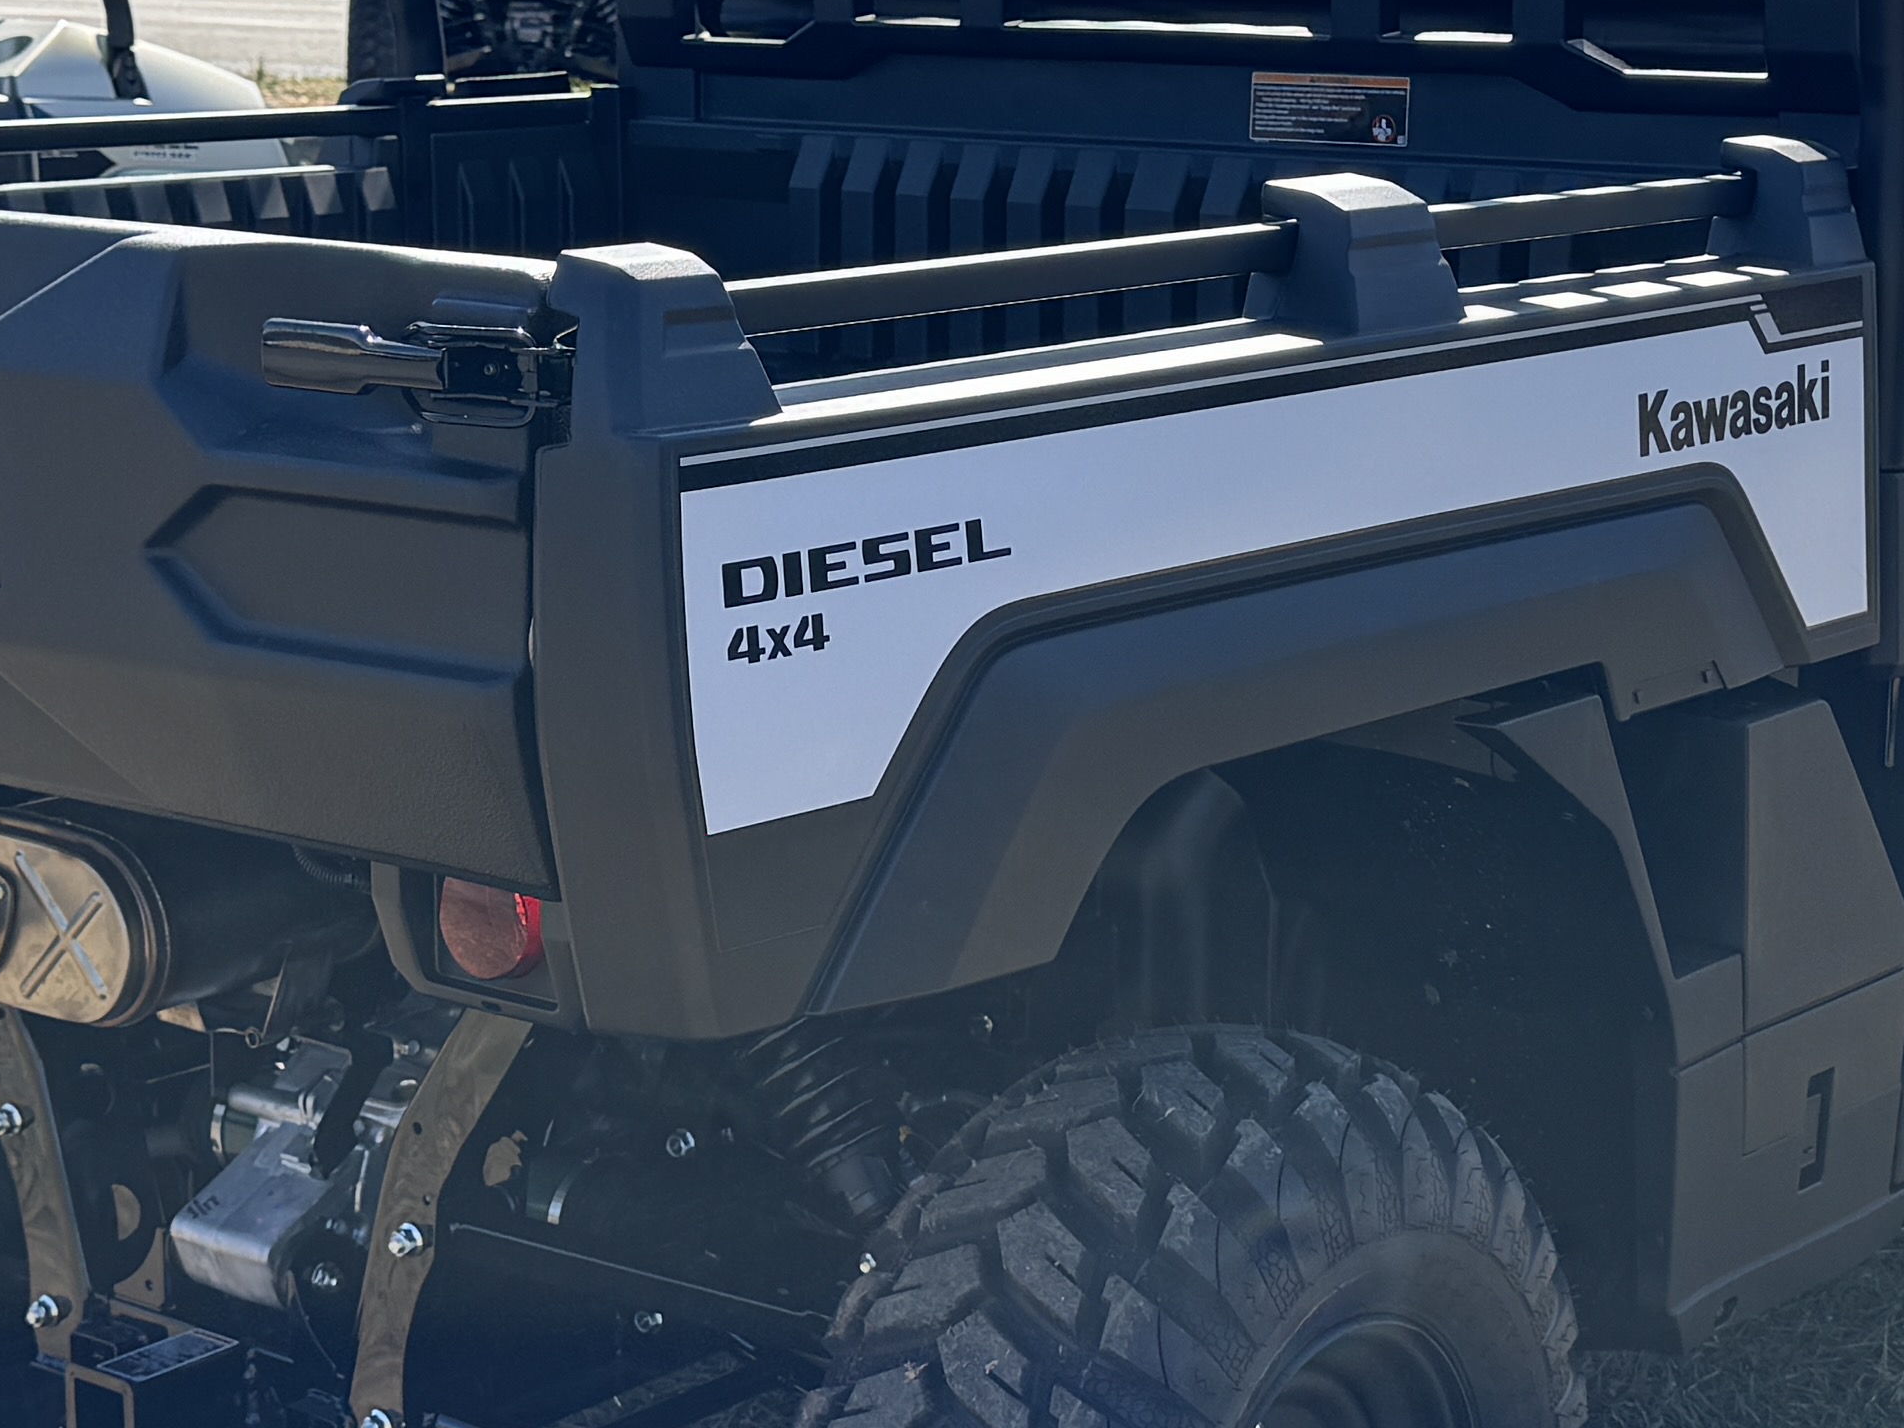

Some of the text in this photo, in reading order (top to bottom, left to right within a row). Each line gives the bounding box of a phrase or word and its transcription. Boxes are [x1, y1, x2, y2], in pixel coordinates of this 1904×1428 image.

[1638, 359, 1830, 458] Kawasaki
[721, 517, 1013, 609] DIESEL
[726, 612, 831, 664] 4x4
